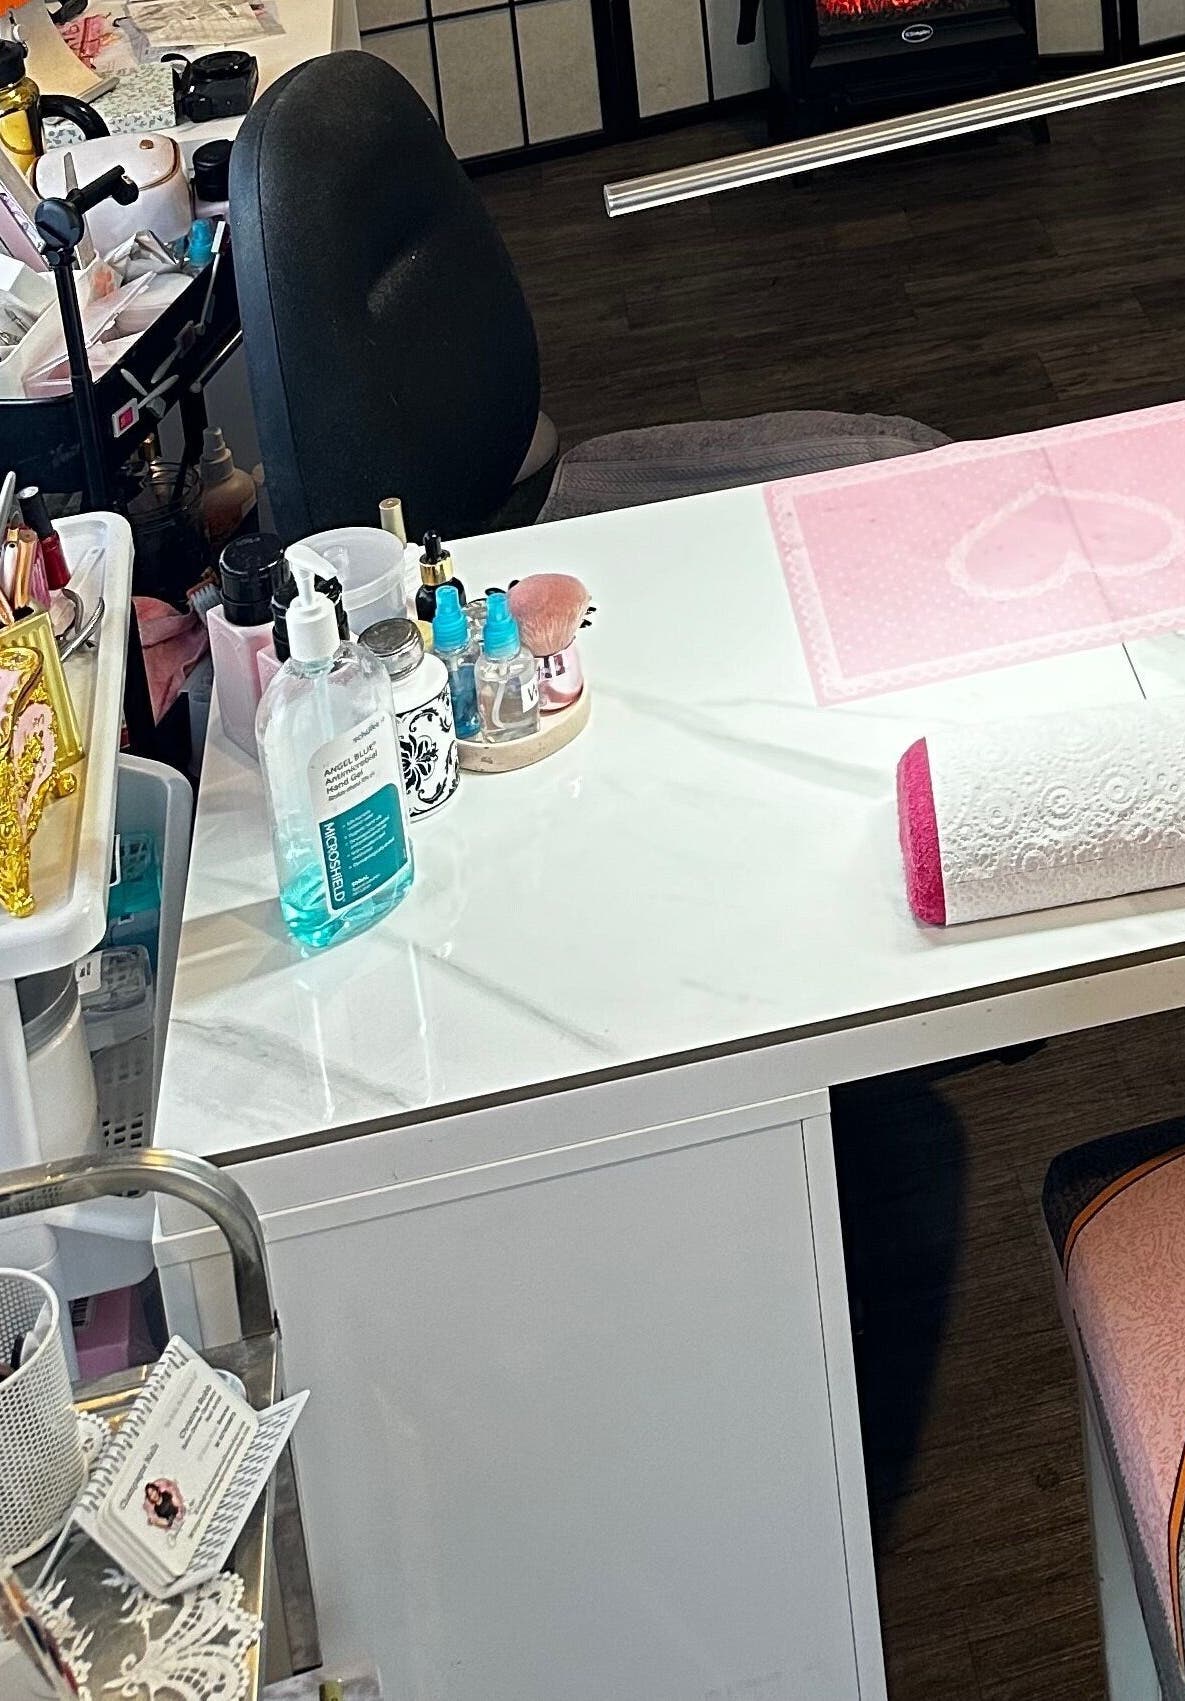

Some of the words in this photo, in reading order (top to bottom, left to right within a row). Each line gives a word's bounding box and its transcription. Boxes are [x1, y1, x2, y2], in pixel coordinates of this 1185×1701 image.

[324, 757, 354, 778] ANGEL
[326, 778, 349, 795] Hand
[350, 769, 364, 782] Gel
